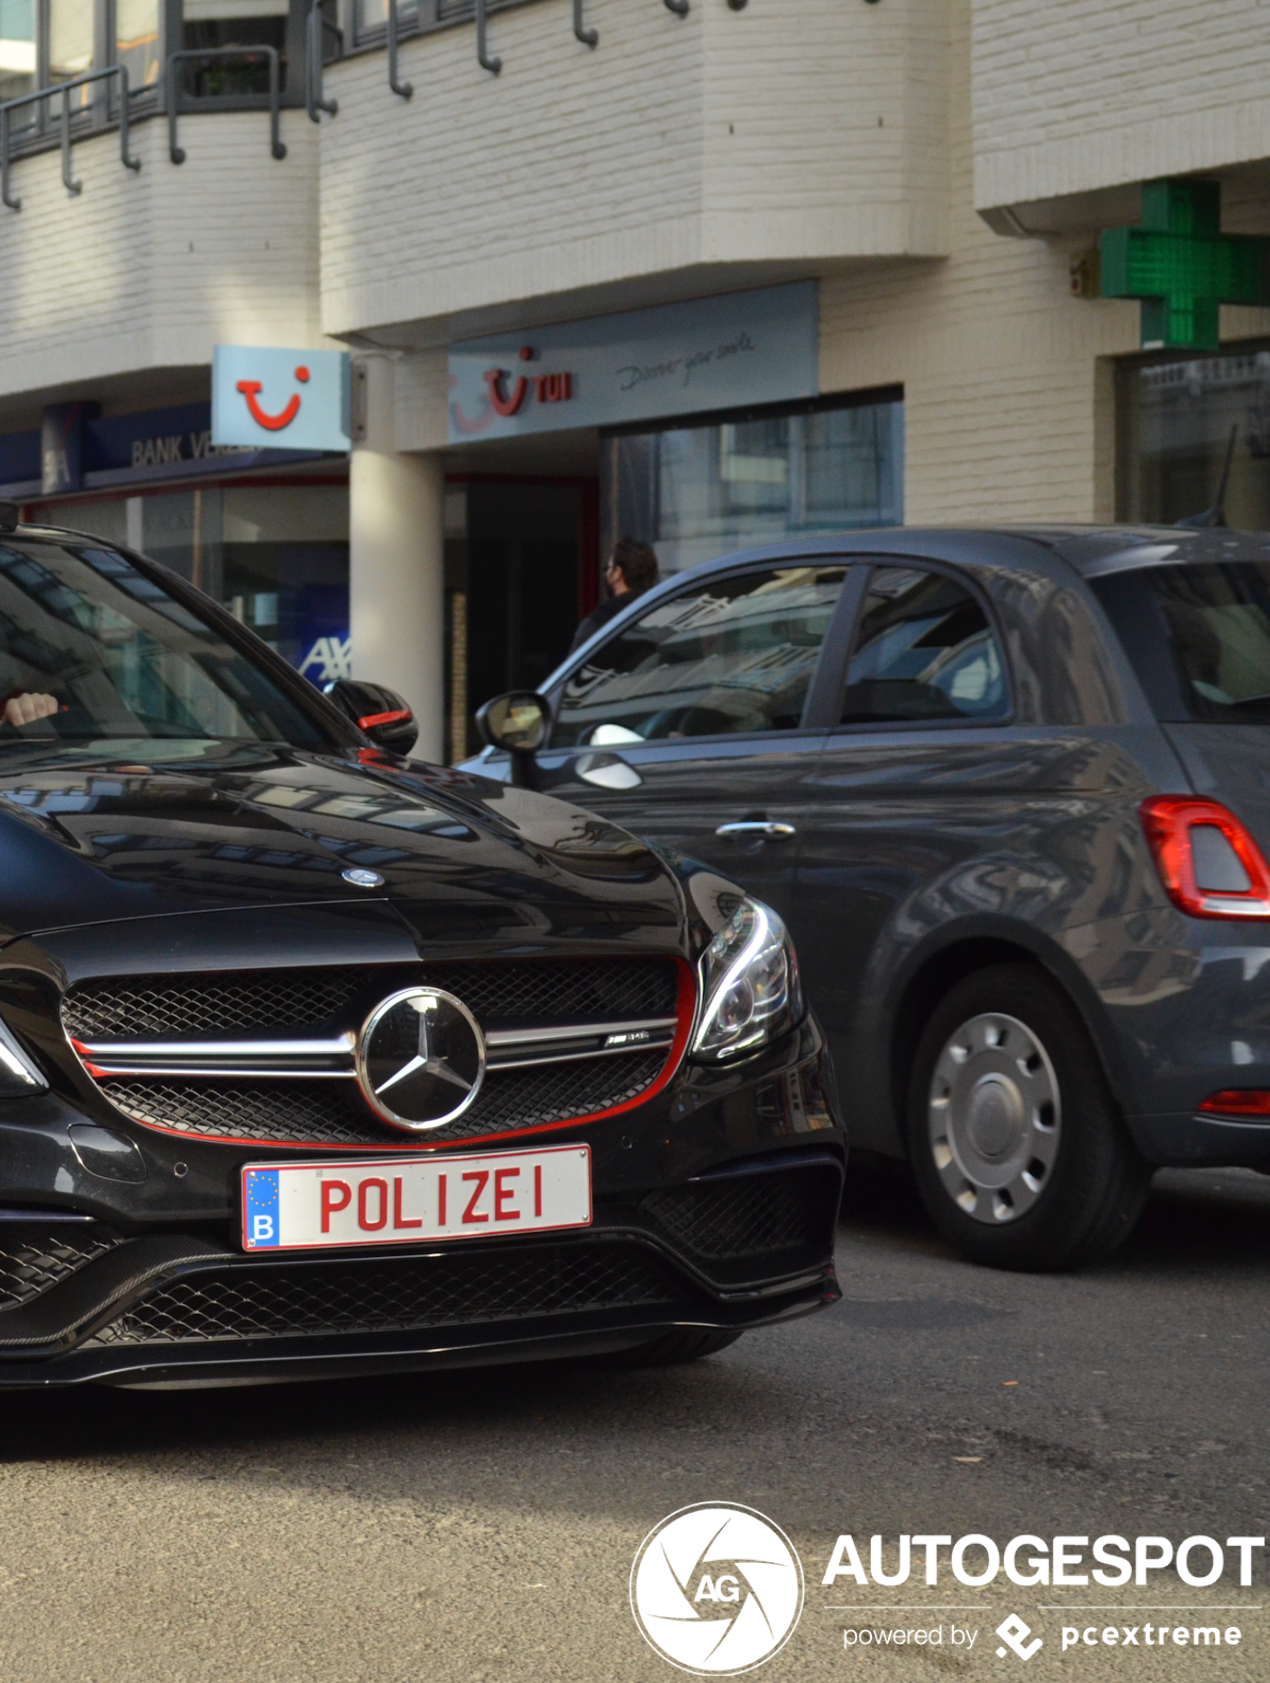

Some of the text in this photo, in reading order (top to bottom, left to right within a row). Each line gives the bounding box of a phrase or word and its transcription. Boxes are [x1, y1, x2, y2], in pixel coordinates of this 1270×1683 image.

[533, 372, 572, 403] TUI
[131, 435, 183, 468] BANK
[320, 1164, 542, 1234] POLIZEI
[253, 1214, 274, 1240] B
